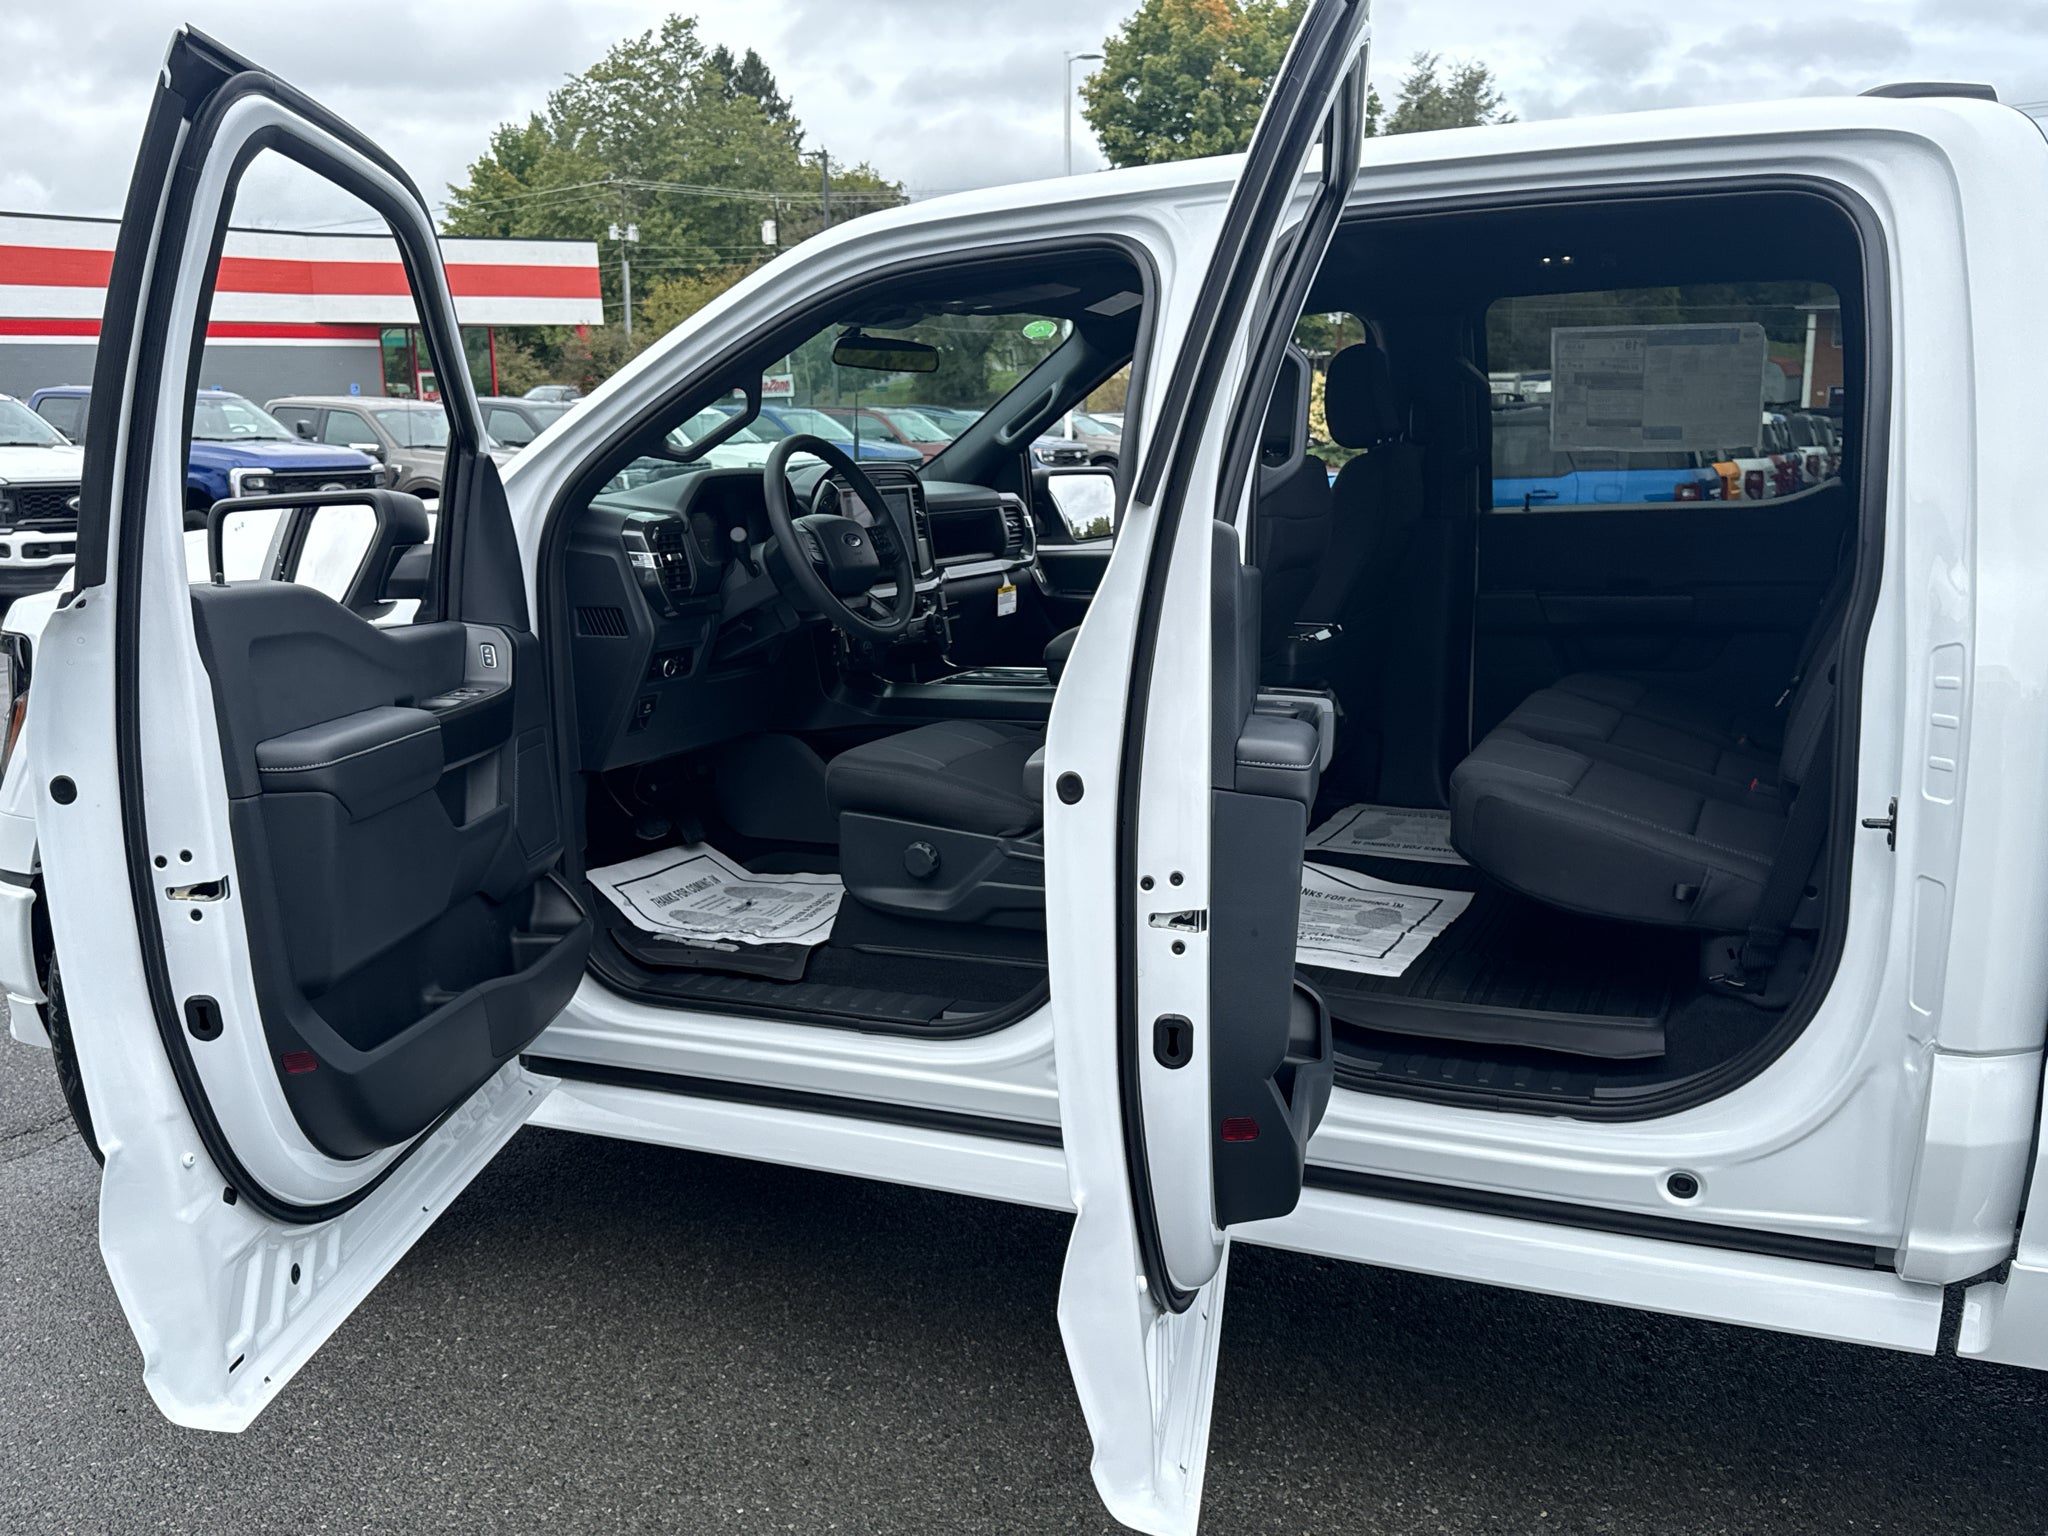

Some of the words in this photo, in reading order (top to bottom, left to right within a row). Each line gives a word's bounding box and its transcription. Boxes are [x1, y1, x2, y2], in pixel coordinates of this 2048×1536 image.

[650, 892, 680, 908] THANKS
[673, 888, 692, 899] FOR
[685, 878, 714, 893] COMING
[708, 875, 721, 884] IN
[1300, 886, 1323, 898] NKS
[1324, 893, 1346, 902] FOR
